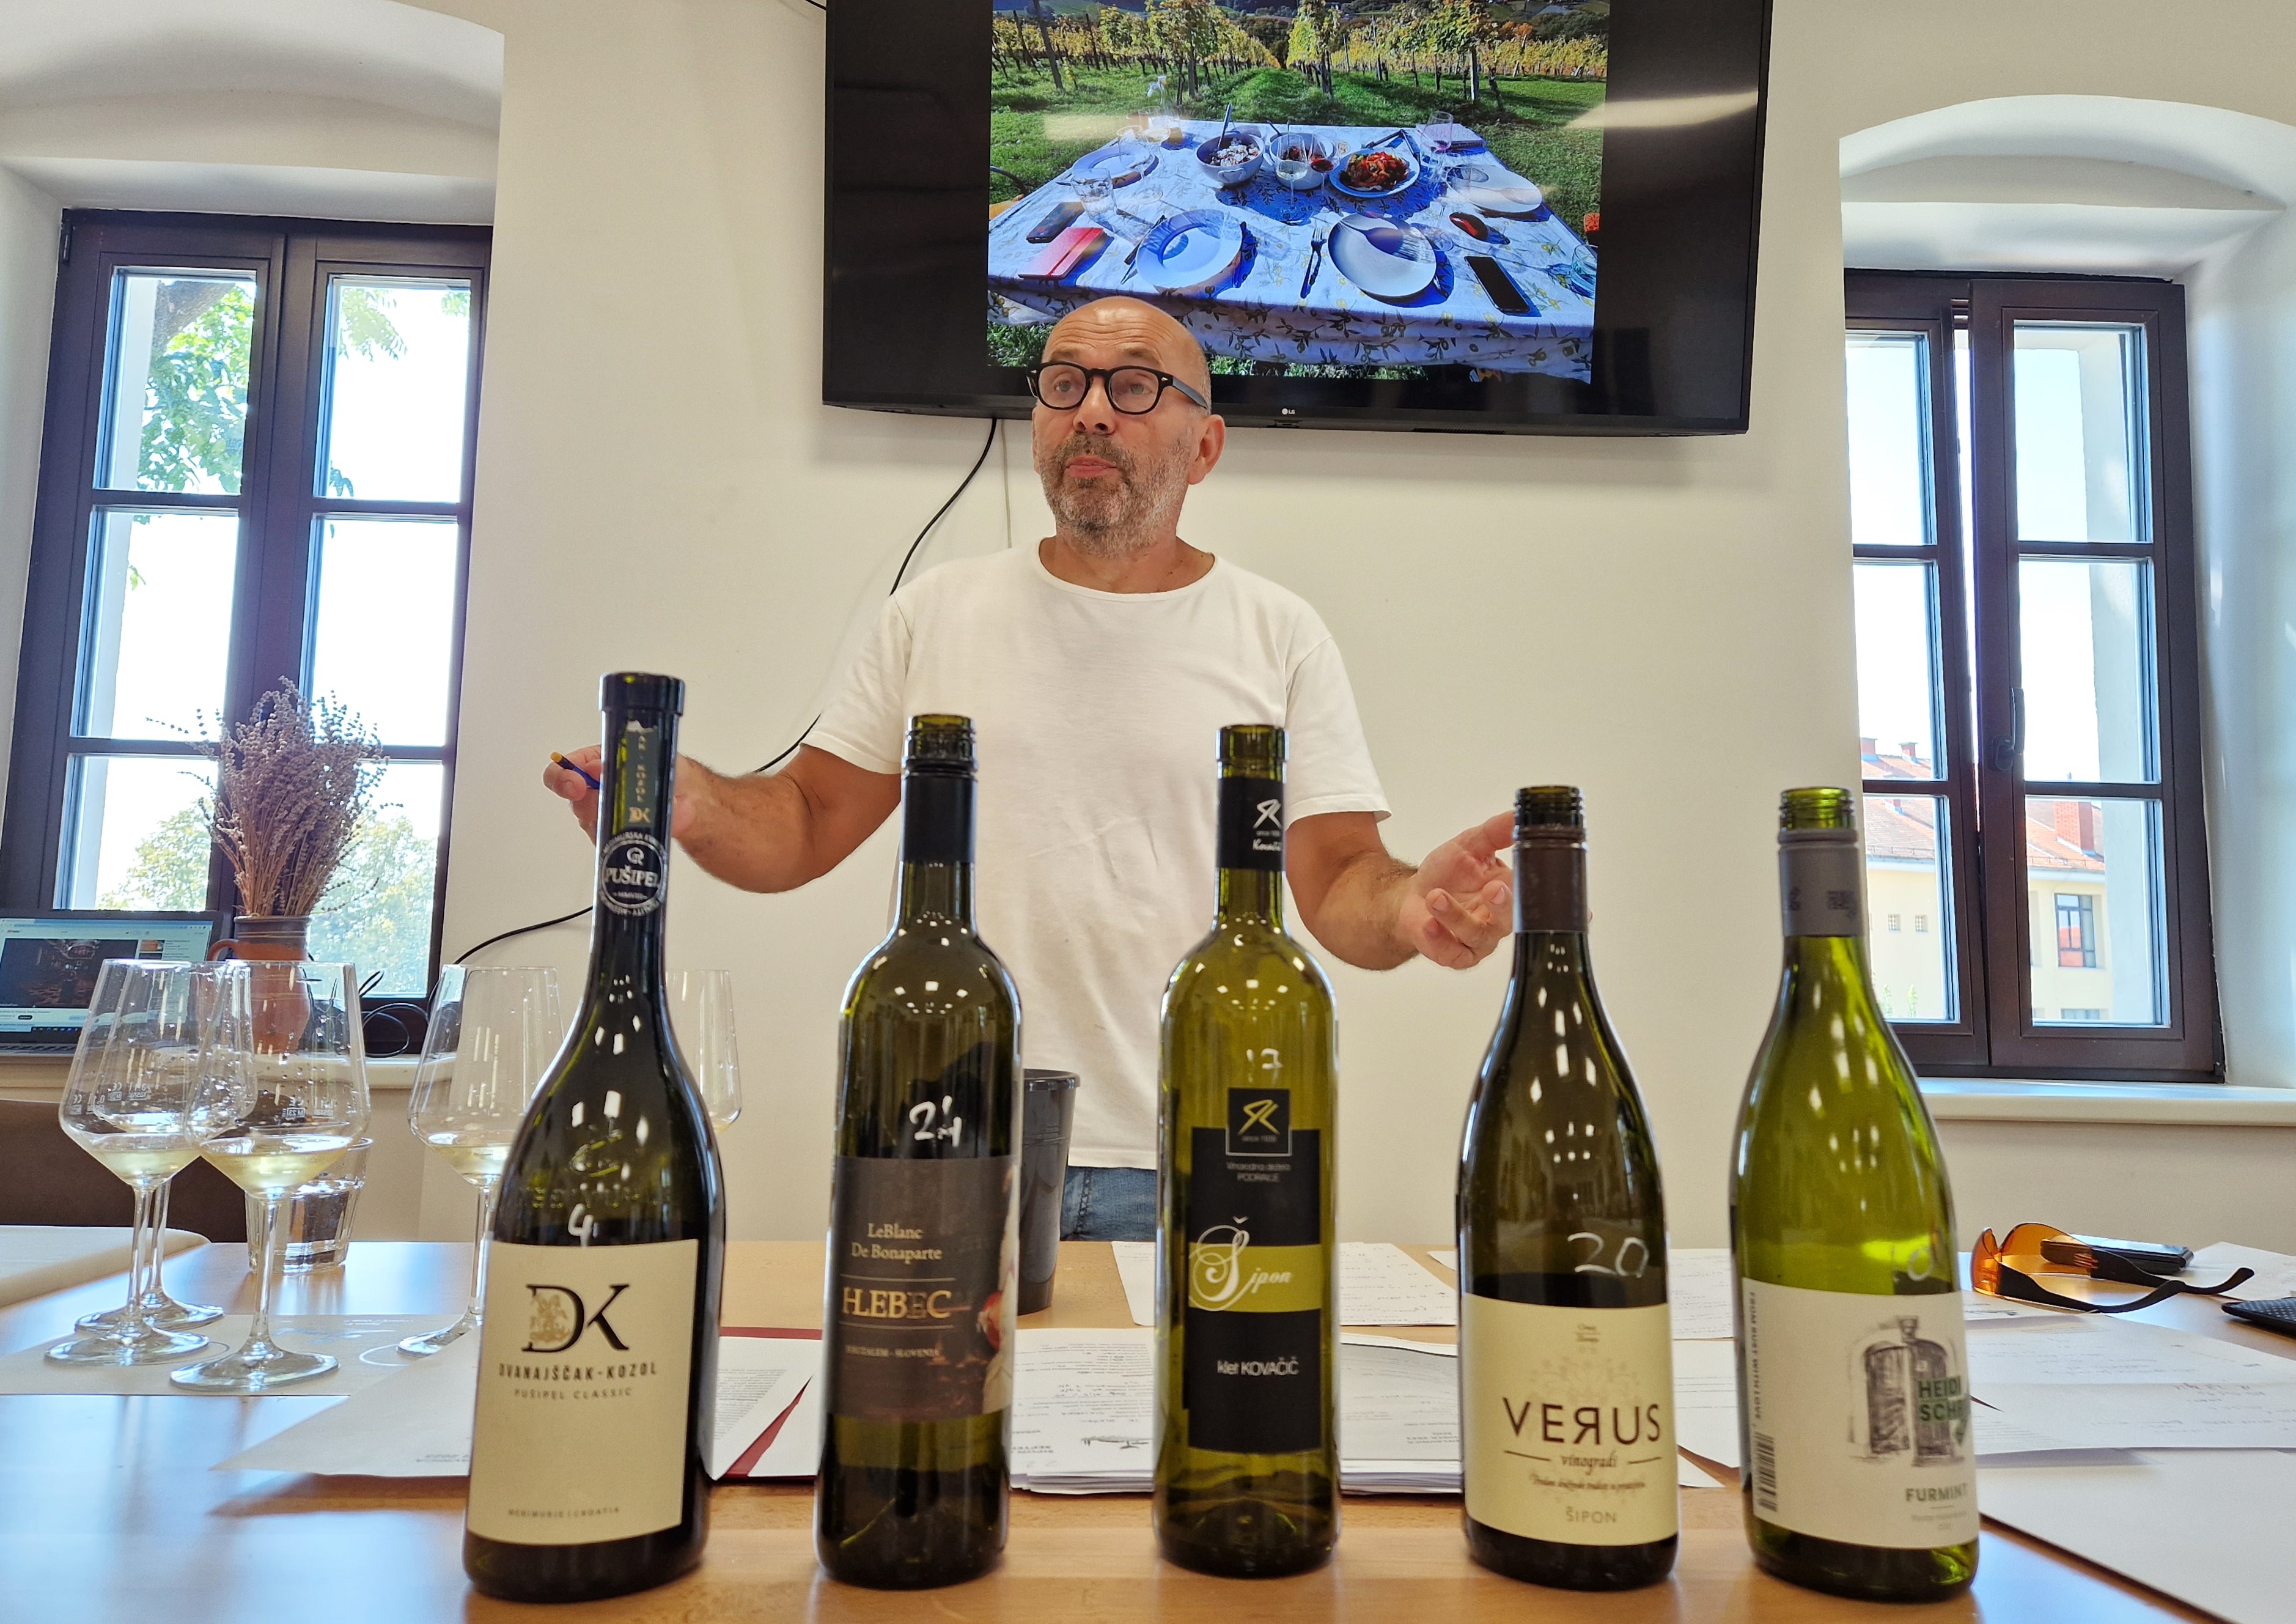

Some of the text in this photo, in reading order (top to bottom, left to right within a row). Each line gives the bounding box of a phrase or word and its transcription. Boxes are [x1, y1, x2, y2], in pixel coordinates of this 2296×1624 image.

[909, 1095, 962, 1147] 24
[867, 1223, 924, 1240] LeBlanc
[851, 1242, 943, 1264] De Bonaparte
[1188, 1216, 1292, 1312] Šipon
[1568, 1231, 1650, 1278] 20
[842, 1286, 952, 1320] HLEBEC
[521, 1283, 630, 1353] DK
[573, 1387, 631, 1400] CLASSIC
[1918, 1375, 1962, 1398] HEIDI
[1561, 1450, 1618, 1475] vinogradi
[1905, 1483, 1967, 1502] FURMINT
[1566, 1505, 1617, 1523] ŠIPON
